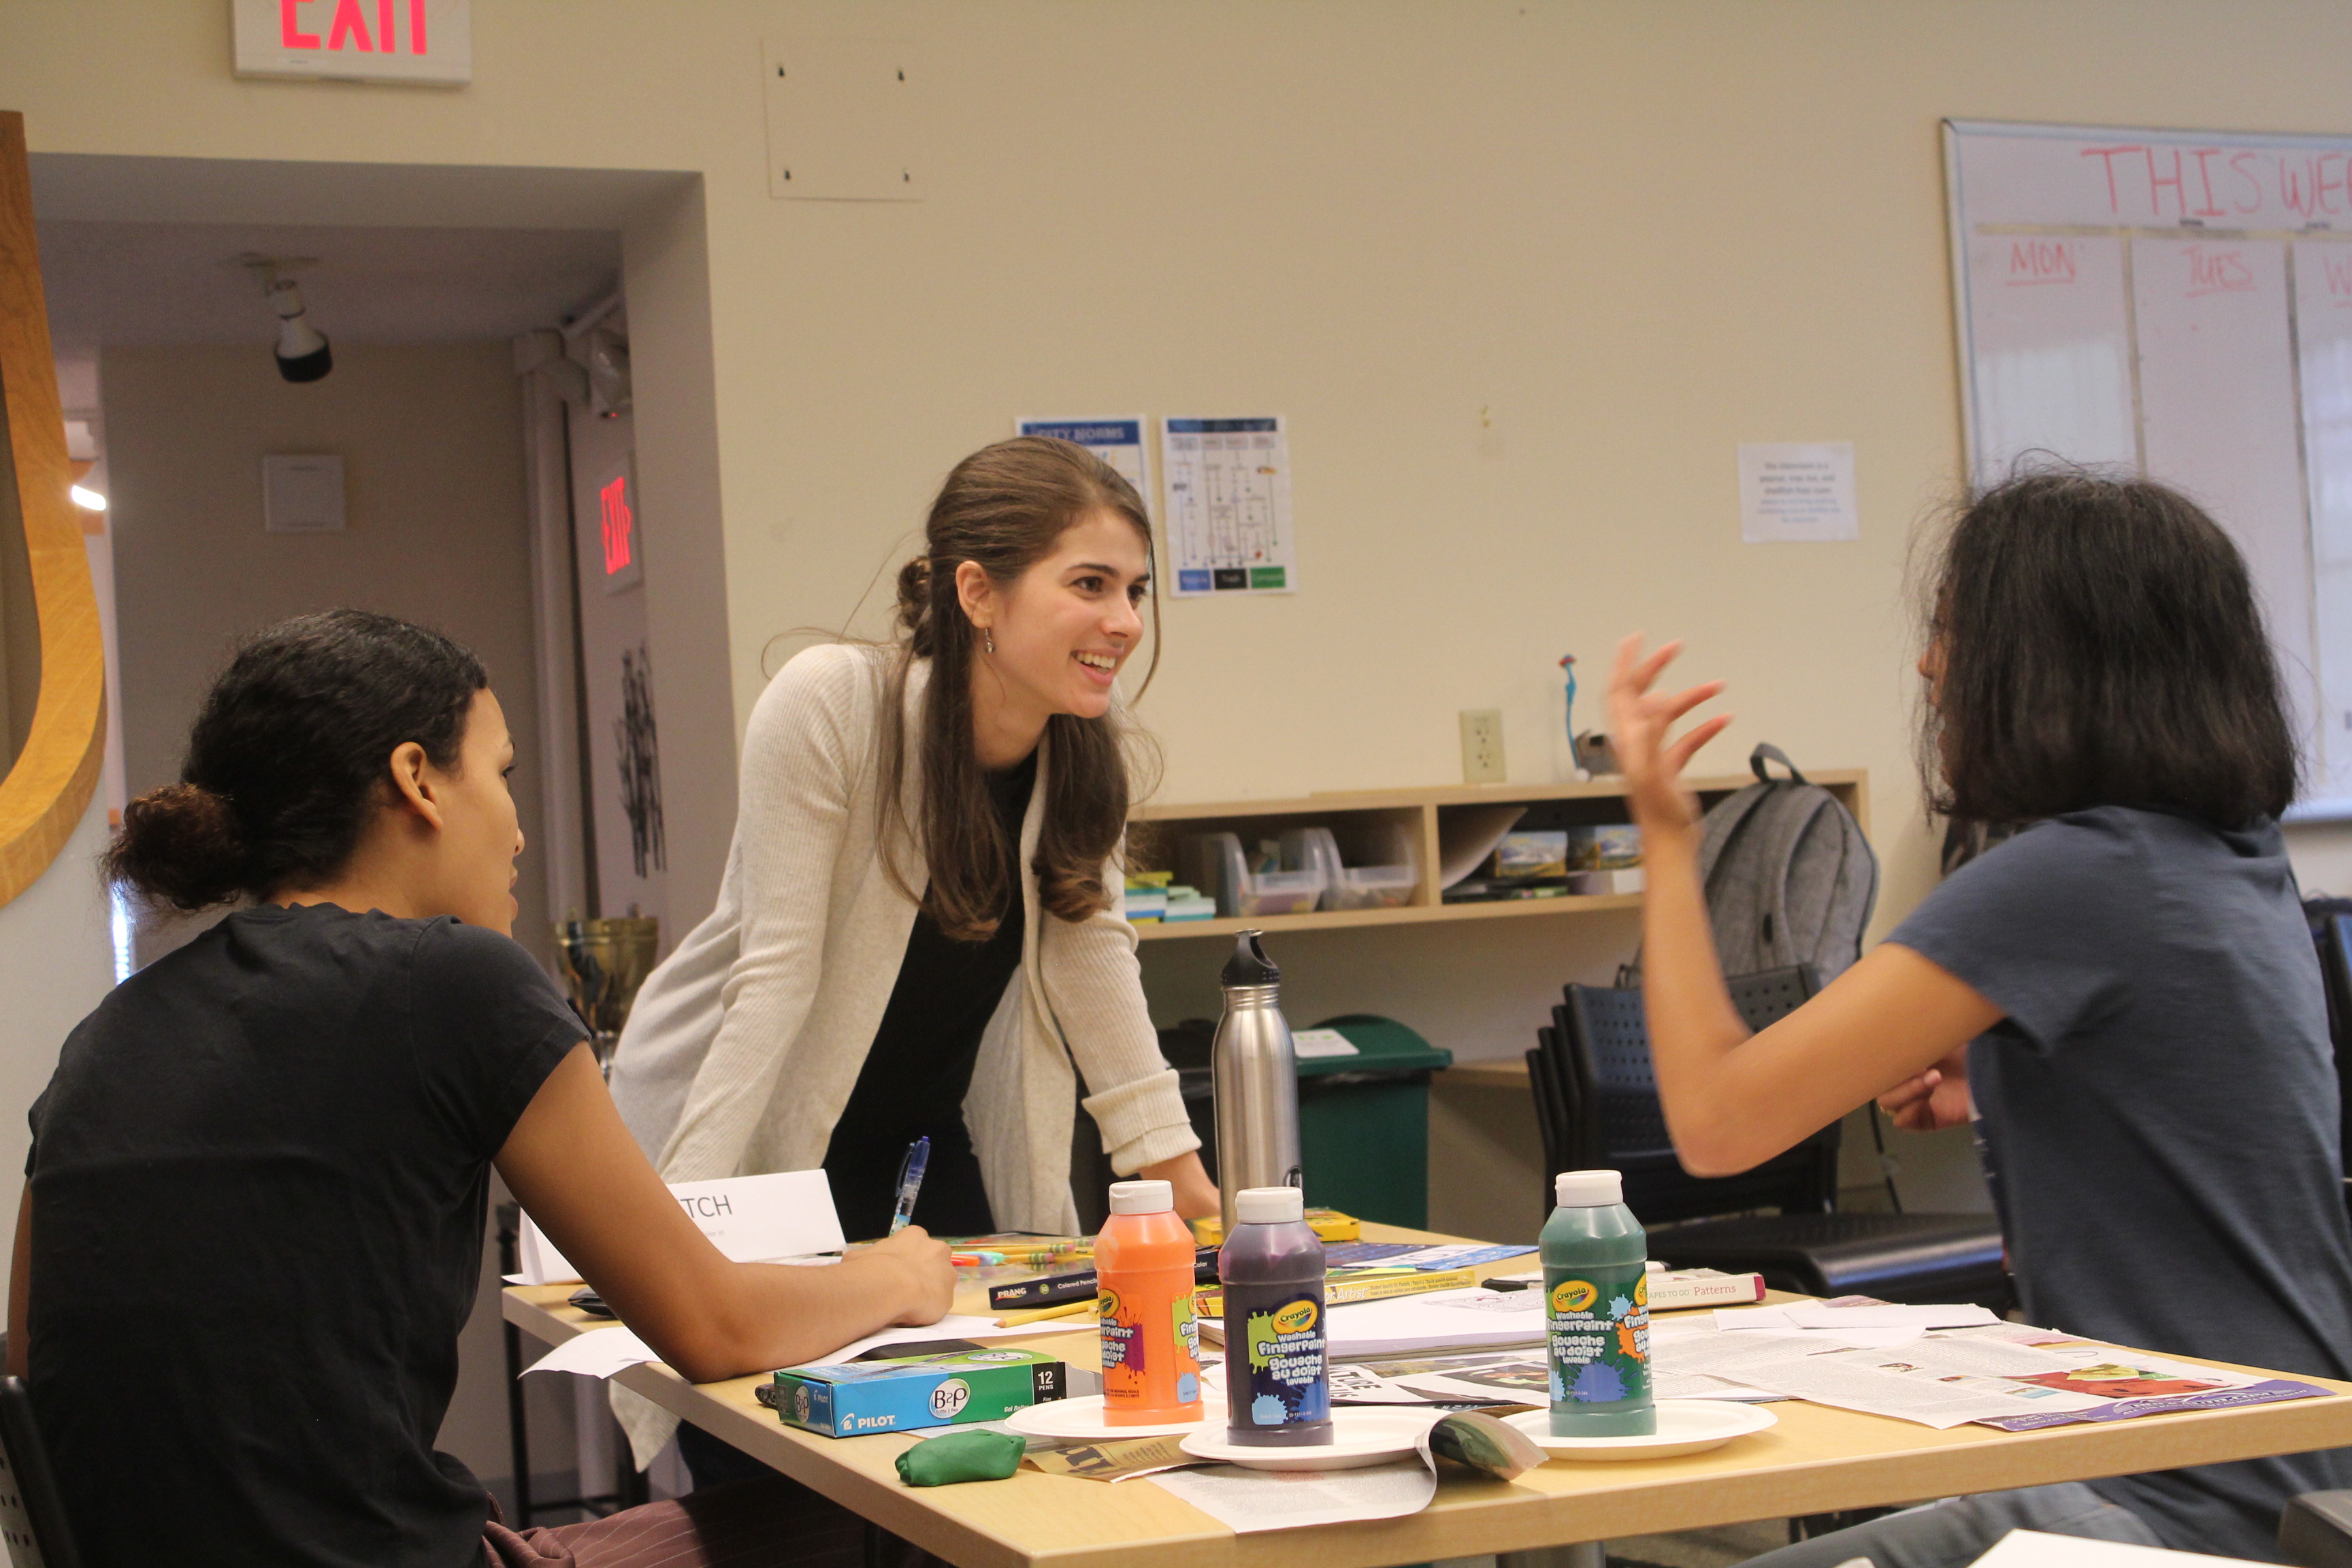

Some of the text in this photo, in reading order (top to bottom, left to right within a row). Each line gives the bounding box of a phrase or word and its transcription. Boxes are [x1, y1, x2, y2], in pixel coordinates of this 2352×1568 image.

[2080, 146, 2352, 218] THIS WE
[2010, 242, 2076, 278] MON
[677, 1194, 732, 1219] TCH
[1058, 1280, 1079, 1290] Colored
[997, 1287, 1027, 1298] PRANG
[1337, 1286, 1370, 1303] Artist
[1557, 1287, 1586, 1300] Crayola
[1649, 1290, 1667, 1299] APES
[1694, 1285, 1737, 1296] Patterns
[1280, 1307, 1311, 1322] Crayola
[1556, 1311, 1594, 1320] Washable
[1278, 1330, 1316, 1342] Washable
[1552, 1334, 1606, 1347] gouache
[1554, 1345, 1604, 1358] au doigt
[1269, 1354, 1322, 1371] gouache
[1562, 1356, 1591, 1365] lavable
[1038, 1371, 1054, 1385] 12
[1271, 1365, 1322, 1381] au doigt
[1286, 1375, 1314, 1386] lavable
[817, 1394, 828, 1403] PILOT
[934, 1387, 968, 1409] B2P
[858, 1415, 896, 1428] PILOT
